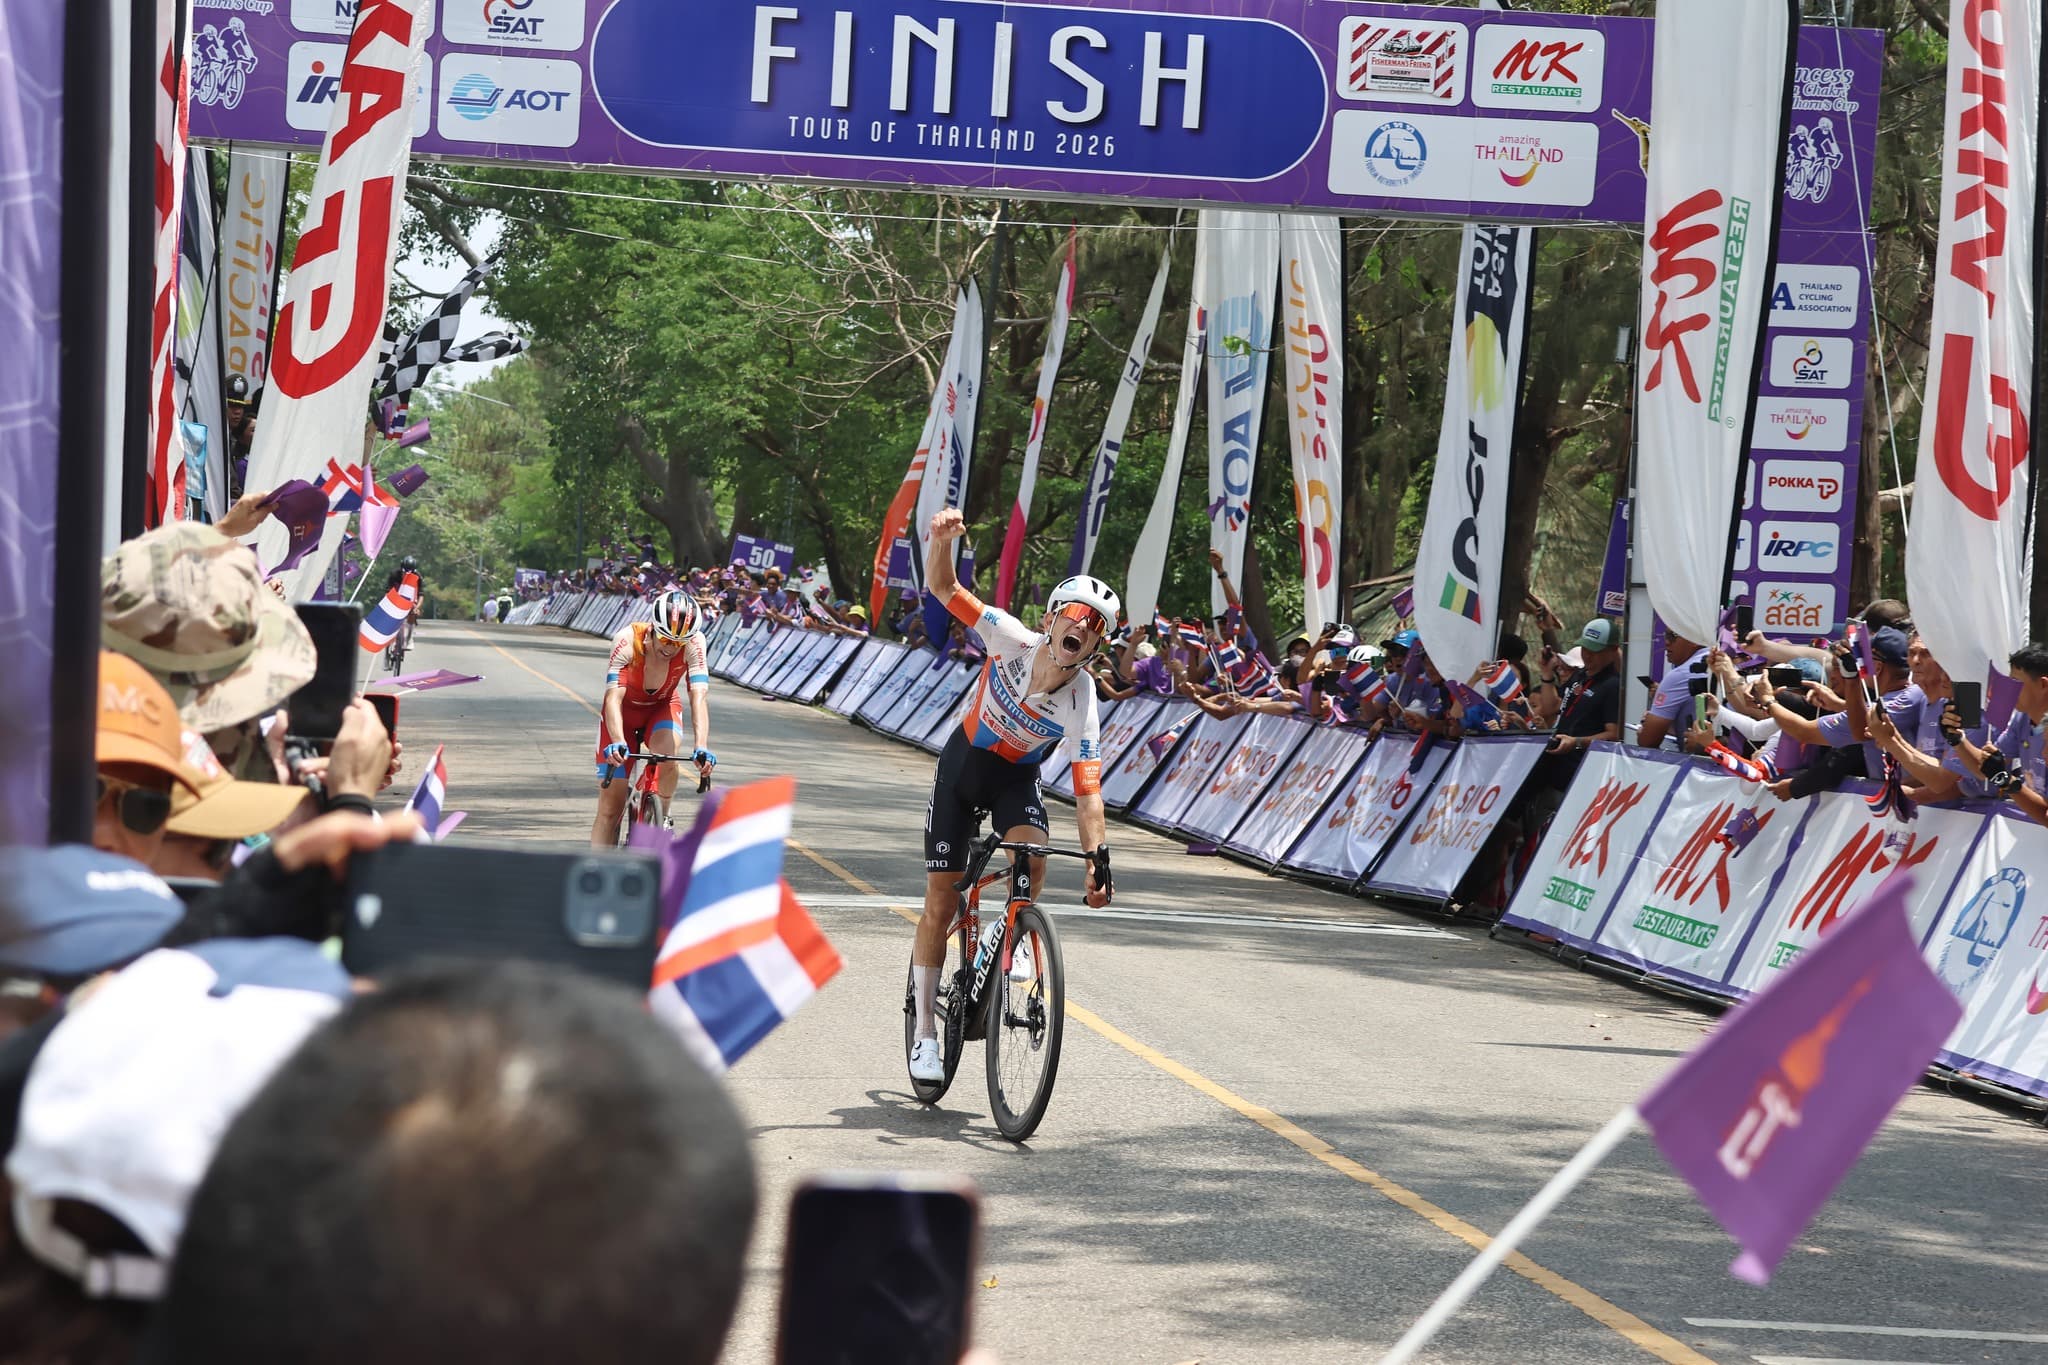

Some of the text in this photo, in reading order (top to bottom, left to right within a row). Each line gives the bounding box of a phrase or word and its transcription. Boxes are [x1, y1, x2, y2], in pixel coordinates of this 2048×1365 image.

[488, 15, 544, 35] SAT
[751, 5, 1205, 129] FINISH
[1493, 39, 1584, 84] MK
[1794, 66, 1855, 85] ncess
[1491, 84, 1581, 97] RESTAURANTS
[504, 89, 571, 112] AOT
[1833, 98, 1860, 115] Cup
[789, 116, 1116, 157] TOUR OF THAILAND 2026
[1498, 135, 1541, 147] amazing
[1474, 145, 1564, 163] THAILAND
[1800, 283, 1843, 291] THAILAND
[1798, 293, 1833, 301] CYCLING
[1797, 304, 1852, 313] ASSOCIATION
[1795, 369, 1828, 380] SAT
[1770, 413, 1827, 425] THAILAND
[1768, 477, 1814, 488] POKKA
[749, 545, 775, 569] 50
[1765, 604, 1823, 626] สสส
[1654, 800, 1776, 915] MK
[1633, 904, 1720, 949] RESTAURANTS
